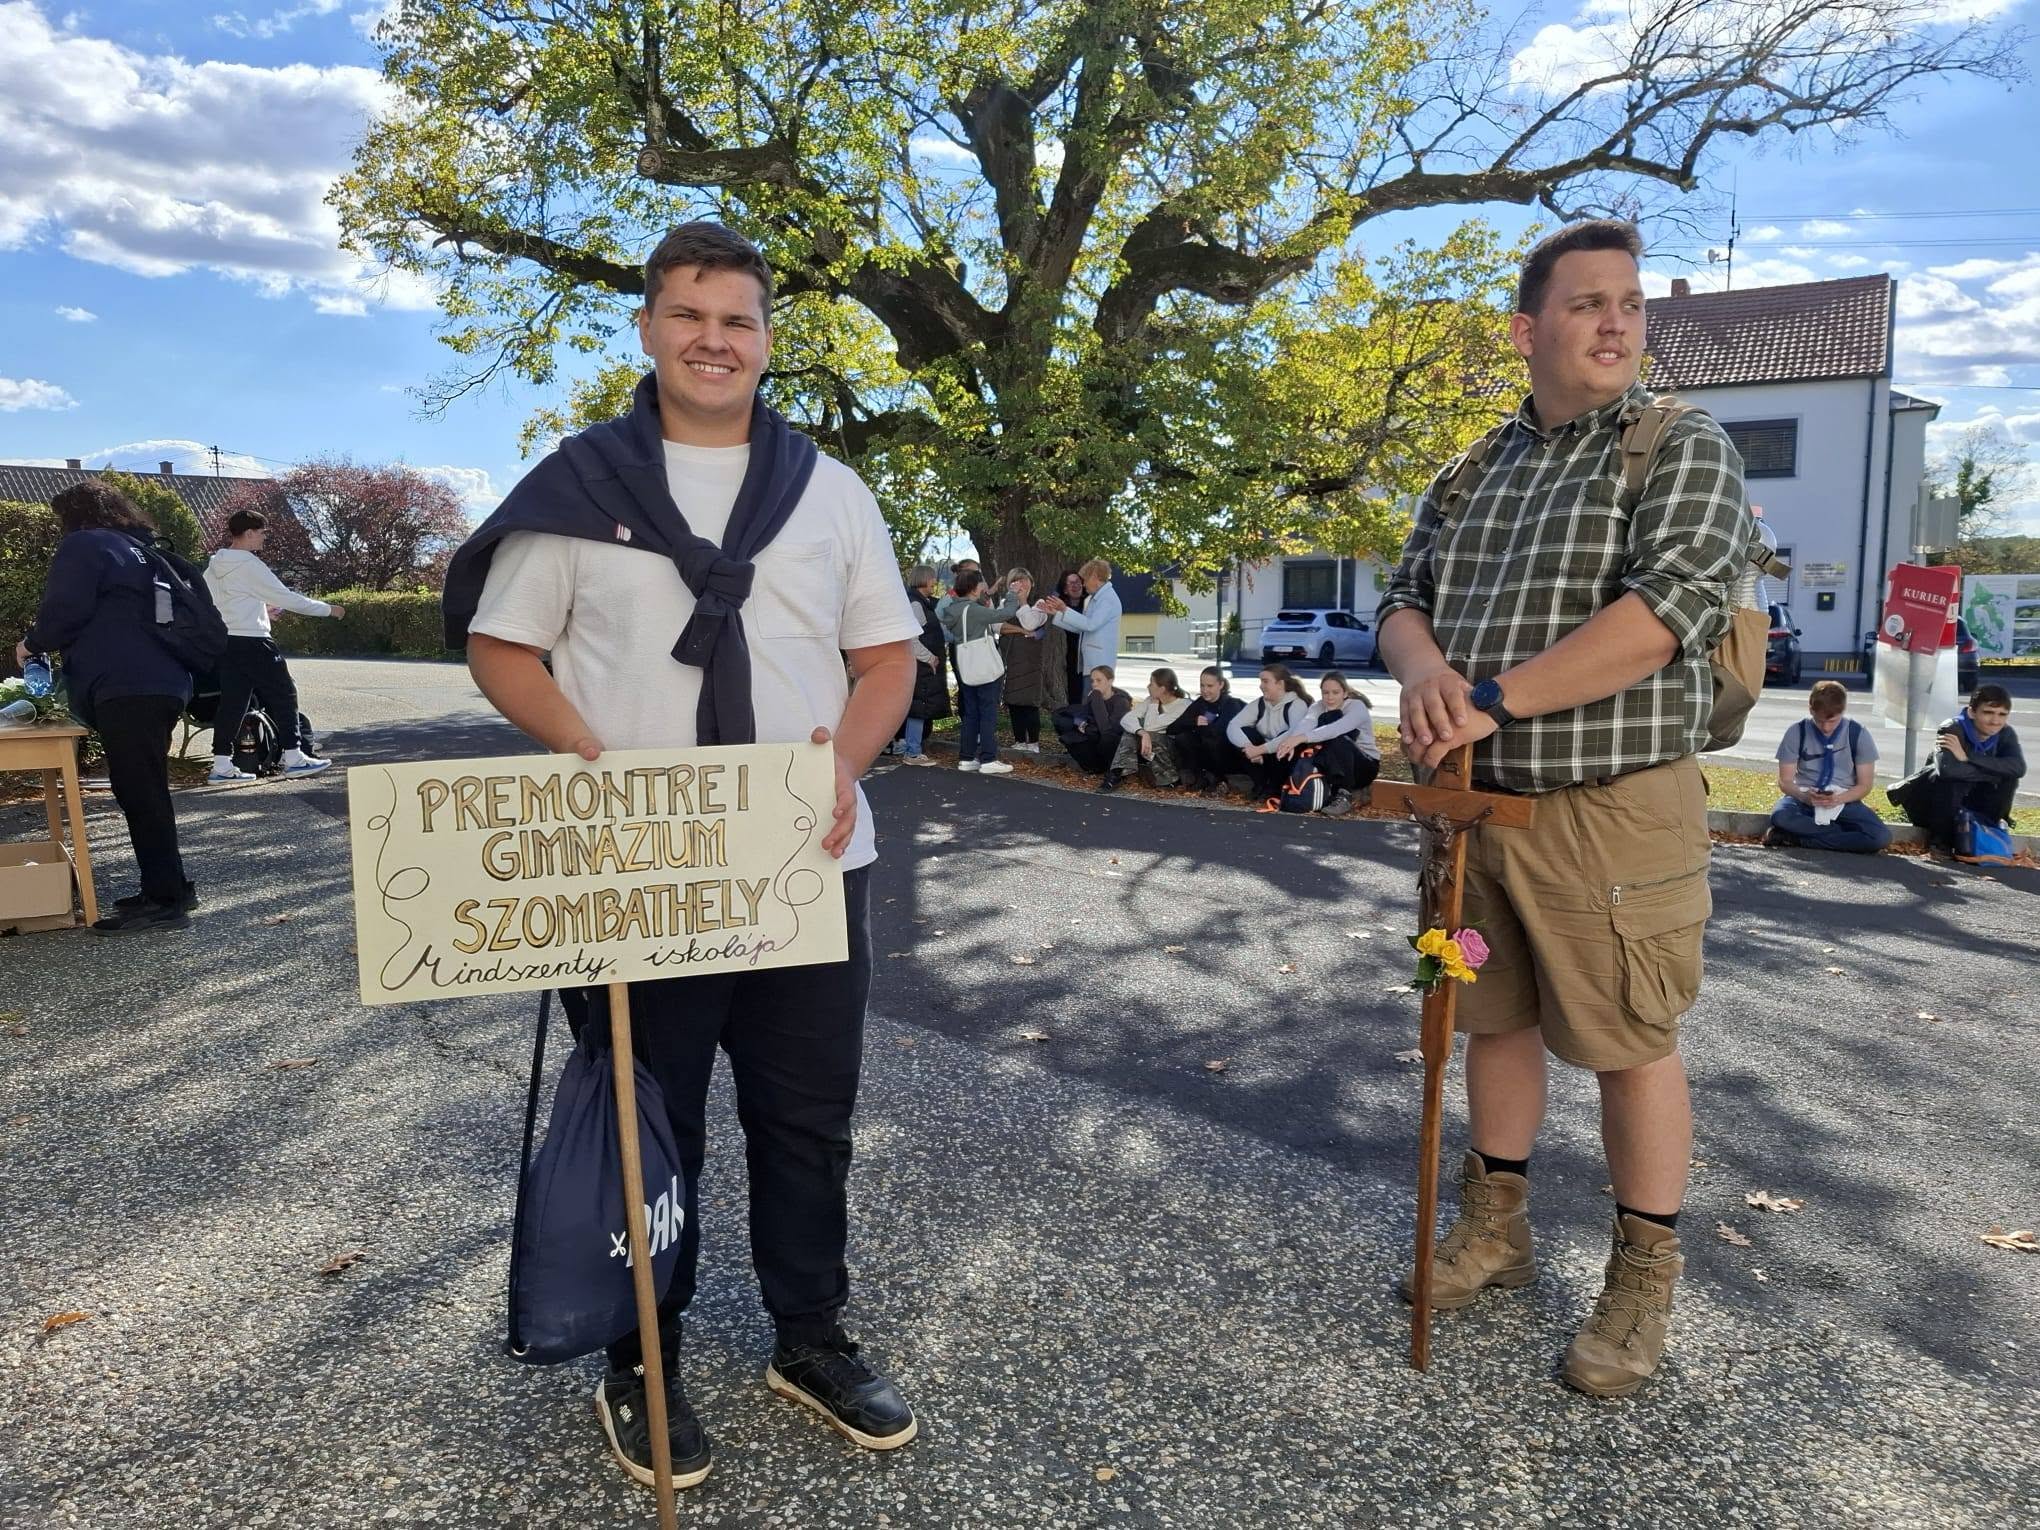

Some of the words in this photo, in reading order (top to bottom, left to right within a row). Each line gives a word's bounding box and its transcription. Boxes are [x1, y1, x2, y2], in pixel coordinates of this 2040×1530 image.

[1903, 587, 1947, 606] KURIER
[451, 877, 771, 954] SZOMBATHELY
[402, 943, 618, 988] Mindszenty
[643, 932, 777, 966] iskolája
